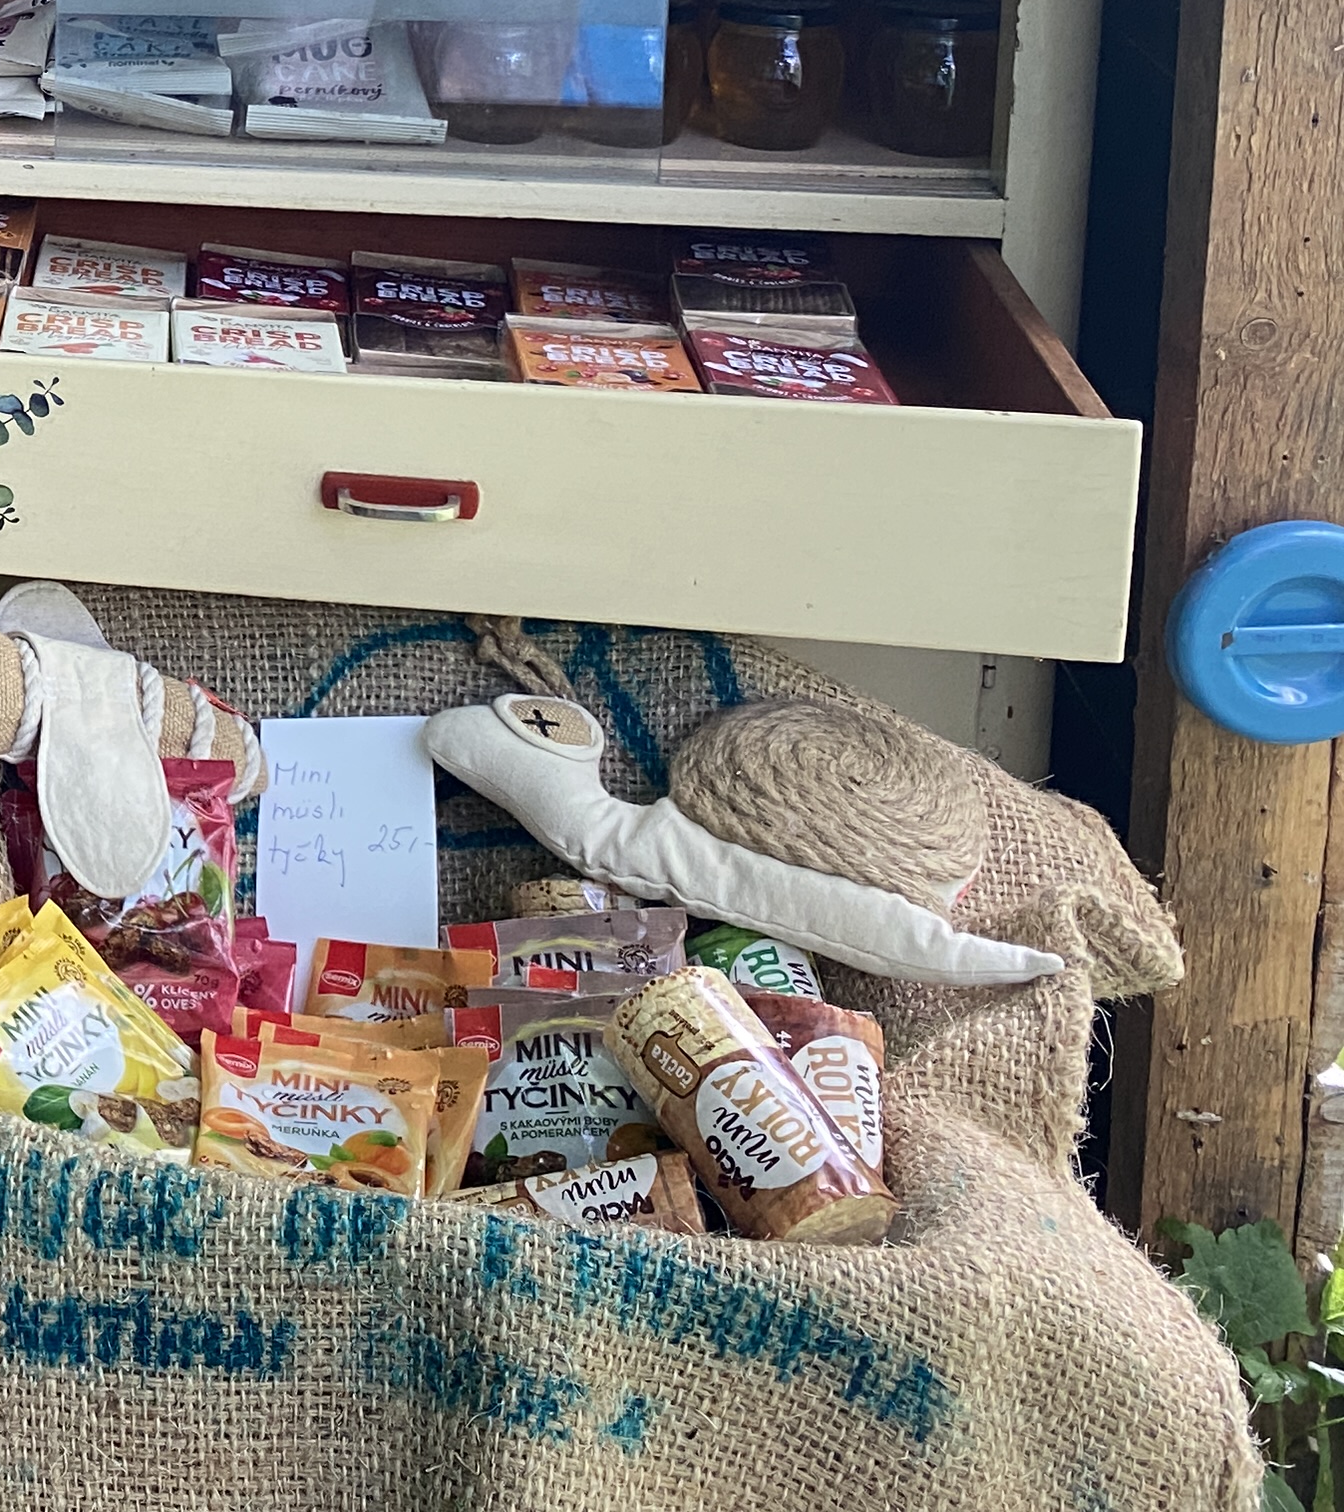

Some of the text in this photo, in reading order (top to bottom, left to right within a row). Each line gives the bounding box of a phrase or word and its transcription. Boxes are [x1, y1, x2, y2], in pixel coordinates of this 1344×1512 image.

[16, 312, 144, 330] CRISP
[16, 324, 142, 340] BREAD
[191, 325, 321, 341] CRISP
[193, 334, 323, 351] BREAD
[274, 761, 332, 786] Mini
[271, 791, 344, 822] müsli
[367, 824, 434, 854] 25,-
[0, 986, 57, 1042] MINI
[162, 998, 197, 1010] OVES
[516, 1032, 593, 1060] MINI
[270, 1069, 353, 1092] MINI
[519, 1060, 588, 1083] müsli
[235, 1088, 393, 1125] TYČINKY
[484, 1082, 639, 1111] TYČINKY
[509, 1115, 580, 1131] KAKAOVÝMI
[582, 1117, 619, 1130] BOBY
[711, 1065, 824, 1167] ROLKY
[271, 1123, 341, 1140] MERUŇKA
[510, 1124, 610, 1141] A POMERANČEM
[713, 1107, 780, 1172] mini
